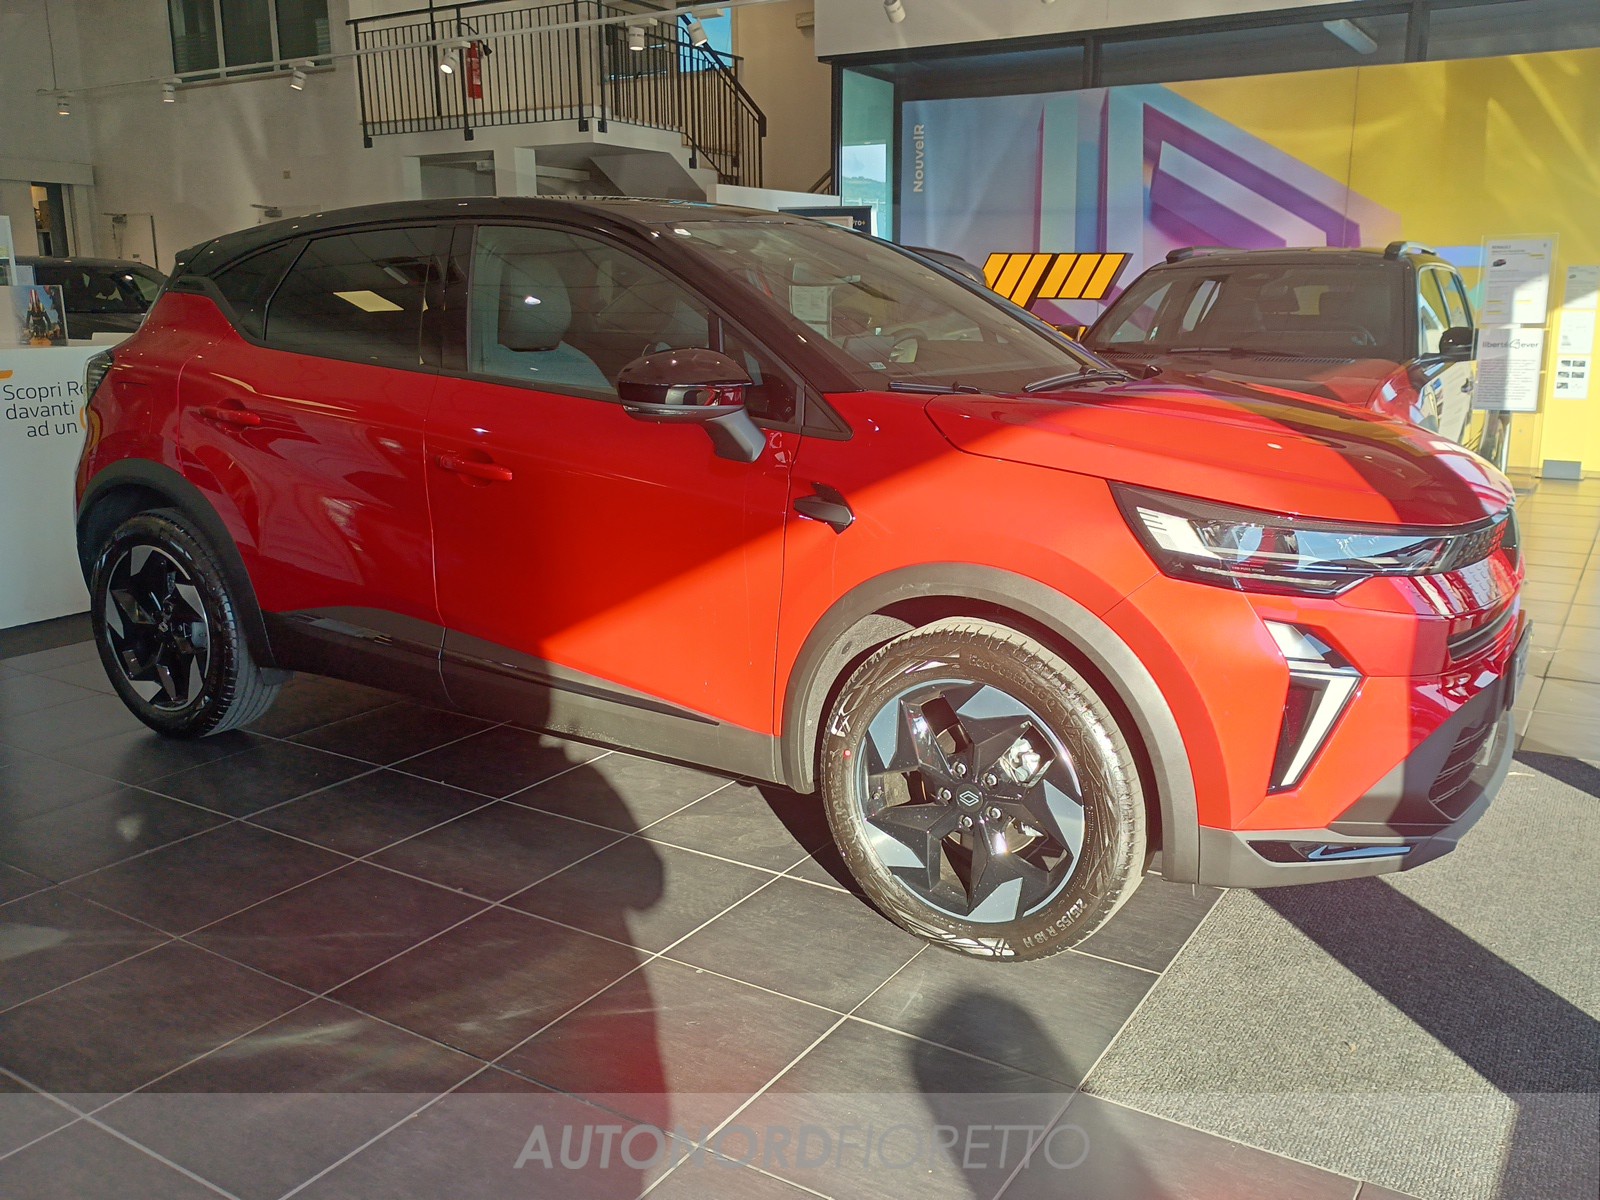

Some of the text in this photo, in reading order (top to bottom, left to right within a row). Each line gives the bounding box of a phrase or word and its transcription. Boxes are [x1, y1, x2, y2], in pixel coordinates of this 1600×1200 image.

[3, 382, 61, 402] Scopri
[6, 400, 74, 420] davanti
[27, 420, 78, 438] ad un
[1056, 898, 1088, 931] 215/55
[1034, 930, 1049, 943] 18
[1045, 925, 1059, 937] R
